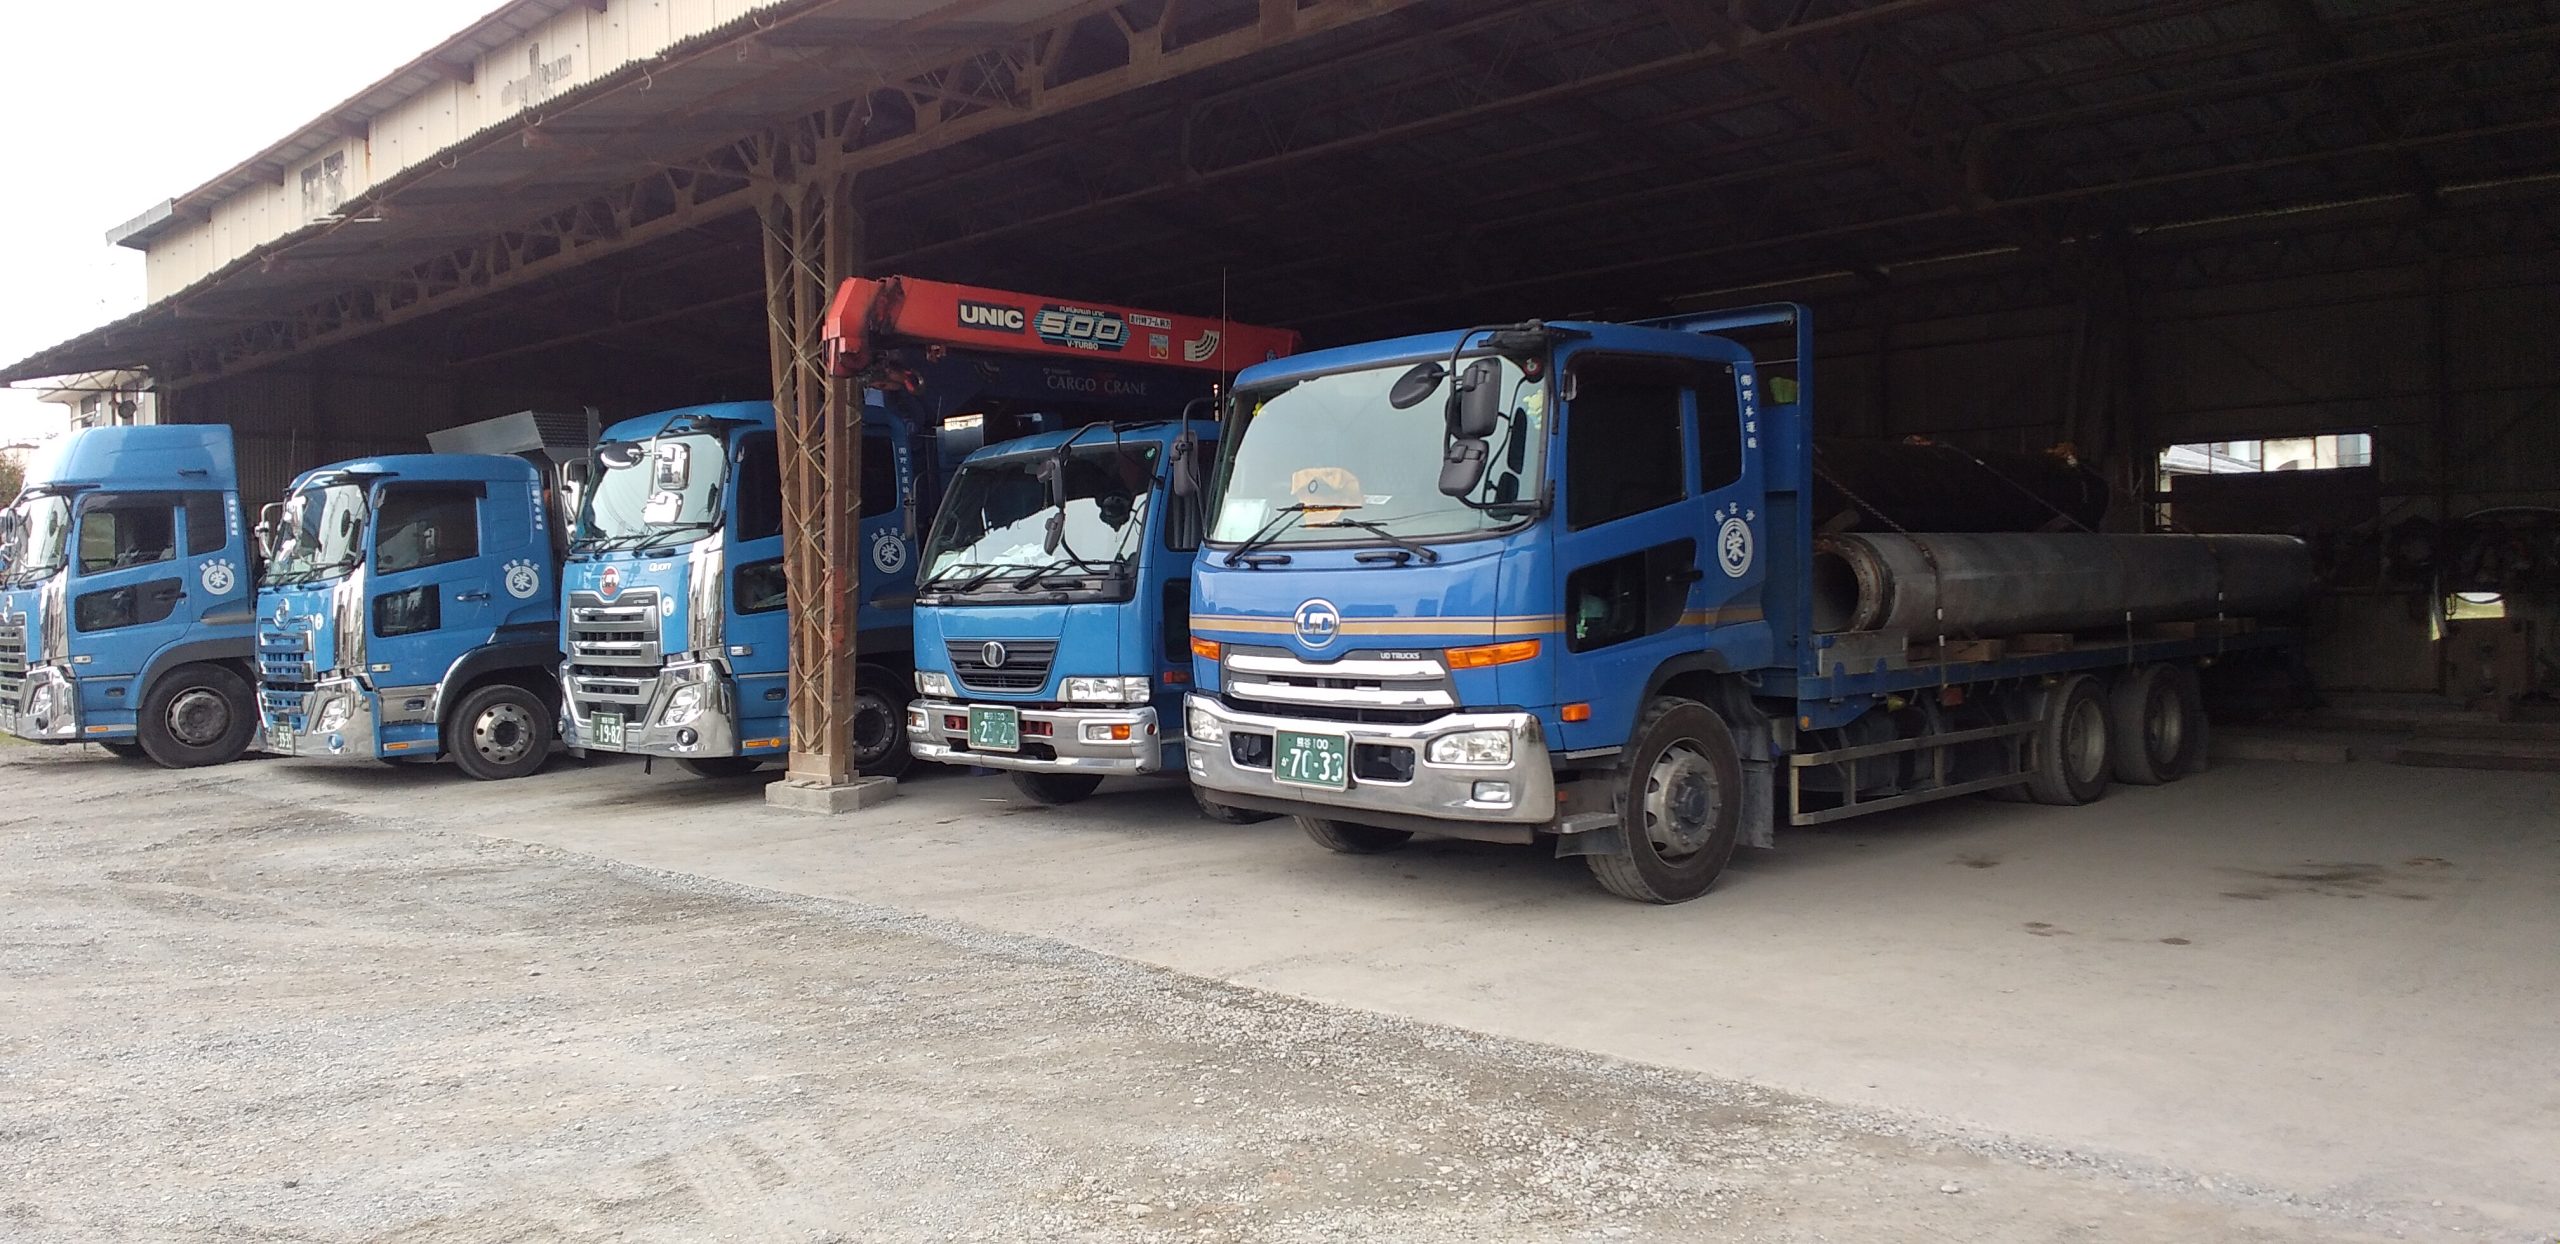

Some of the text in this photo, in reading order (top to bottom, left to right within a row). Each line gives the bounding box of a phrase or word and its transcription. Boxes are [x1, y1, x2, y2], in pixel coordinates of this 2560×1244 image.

[960, 305, 1023, 329] UNIC
[1040, 313, 1121, 341] 500
[1066, 340, 1098, 350] V-TURBO
[1047, 376, 1147, 396] CARGO CRANE
